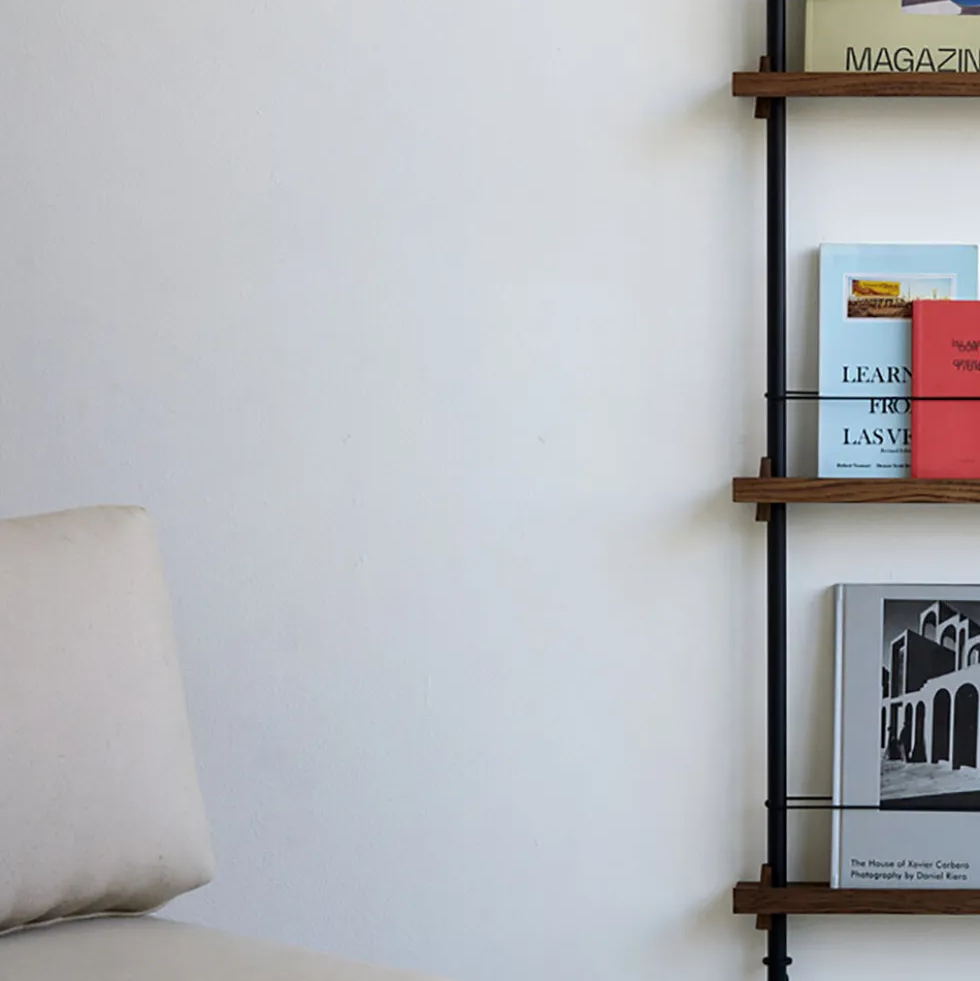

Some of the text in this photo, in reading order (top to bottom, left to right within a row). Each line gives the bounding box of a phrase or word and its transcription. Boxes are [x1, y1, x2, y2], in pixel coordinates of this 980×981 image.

[869, 397, 912, 414] FRO
[844, 428, 884, 445] LAS
[850, 858, 866, 867] The
[868, 858, 894, 868] House
[896, 860, 906, 868] of
[908, 860, 933, 868] Xavier
[850, 870, 968, 881] Photography by Daniel Riera
